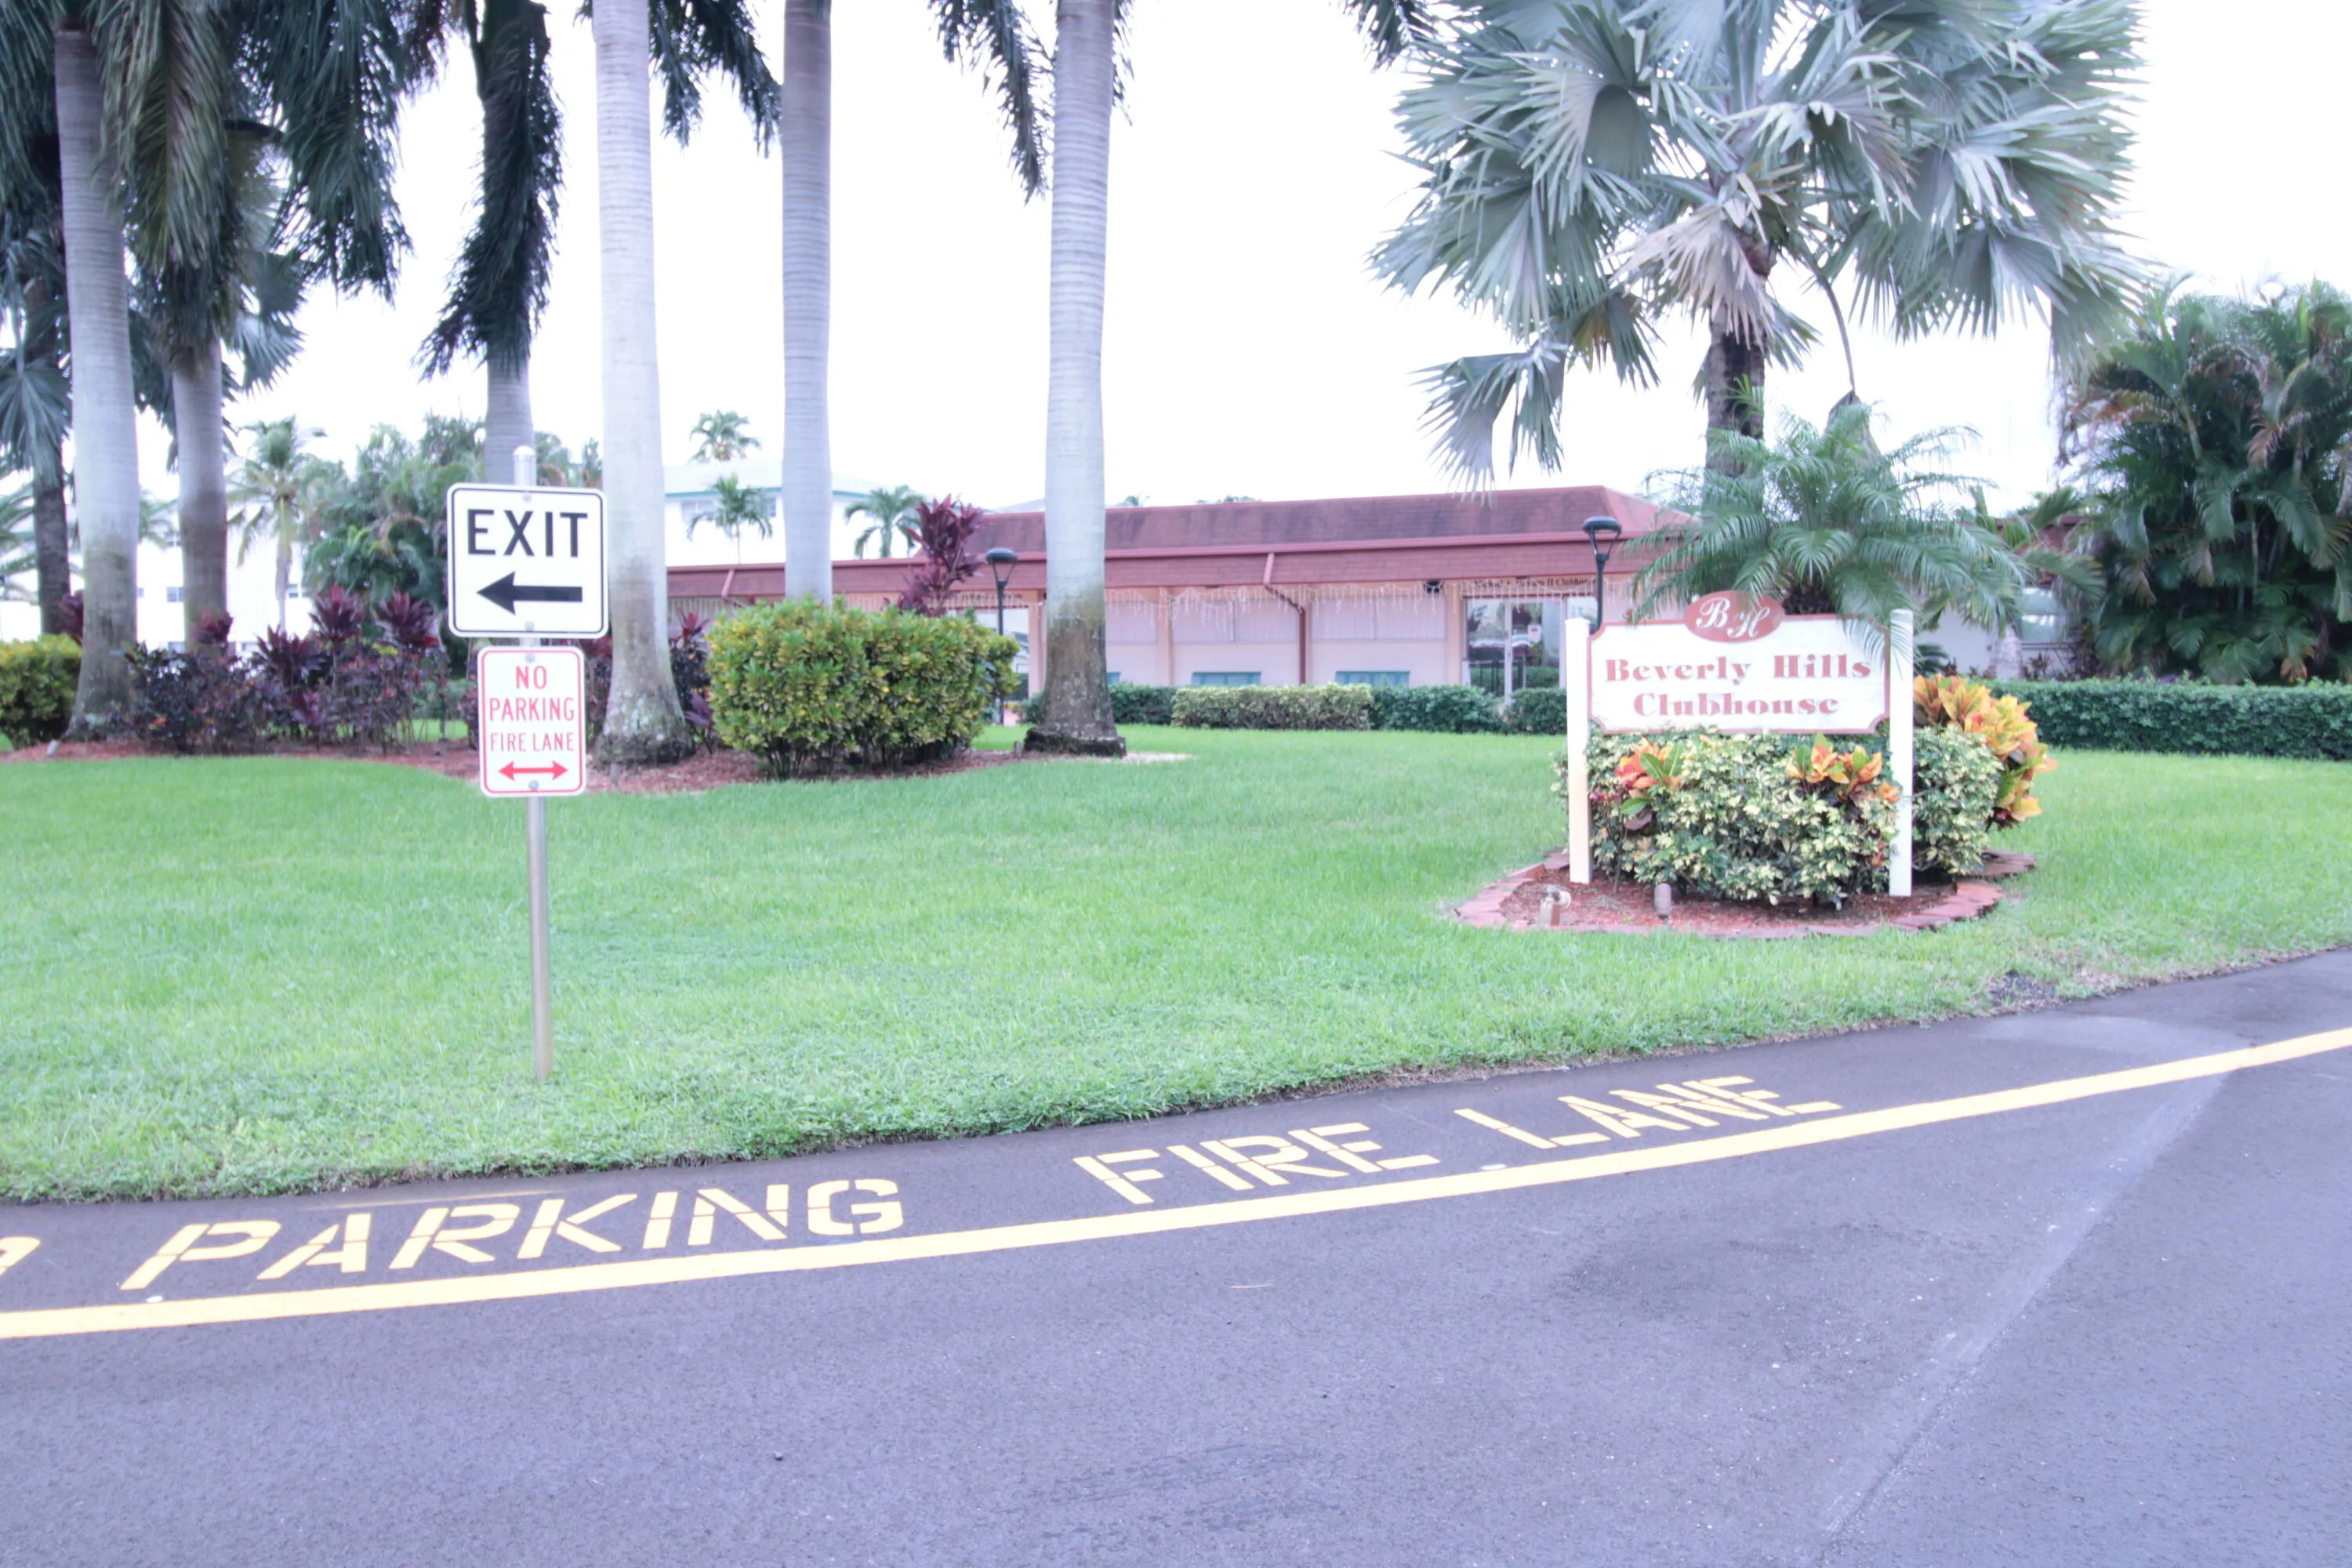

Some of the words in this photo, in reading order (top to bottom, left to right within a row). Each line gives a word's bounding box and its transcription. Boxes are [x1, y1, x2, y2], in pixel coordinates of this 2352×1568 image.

[466, 508, 588, 557] EXIT
[1555, 576, 1597, 586] Clubhoue
[515, 665, 547, 690] NO
[1606, 655, 1751, 685] Beverly
[1773, 654, 1871, 679] Hills
[489, 697, 575, 721] PARKING
[1633, 692, 1839, 717] Clubhouse
[490, 732, 527, 753] FIRE
[532, 732, 575, 752] LANE
[119, 1178, 903, 1290] PARKING
[1073, 1121, 1441, 1205] FIRE
[1454, 1075, 1844, 1150] LANE
